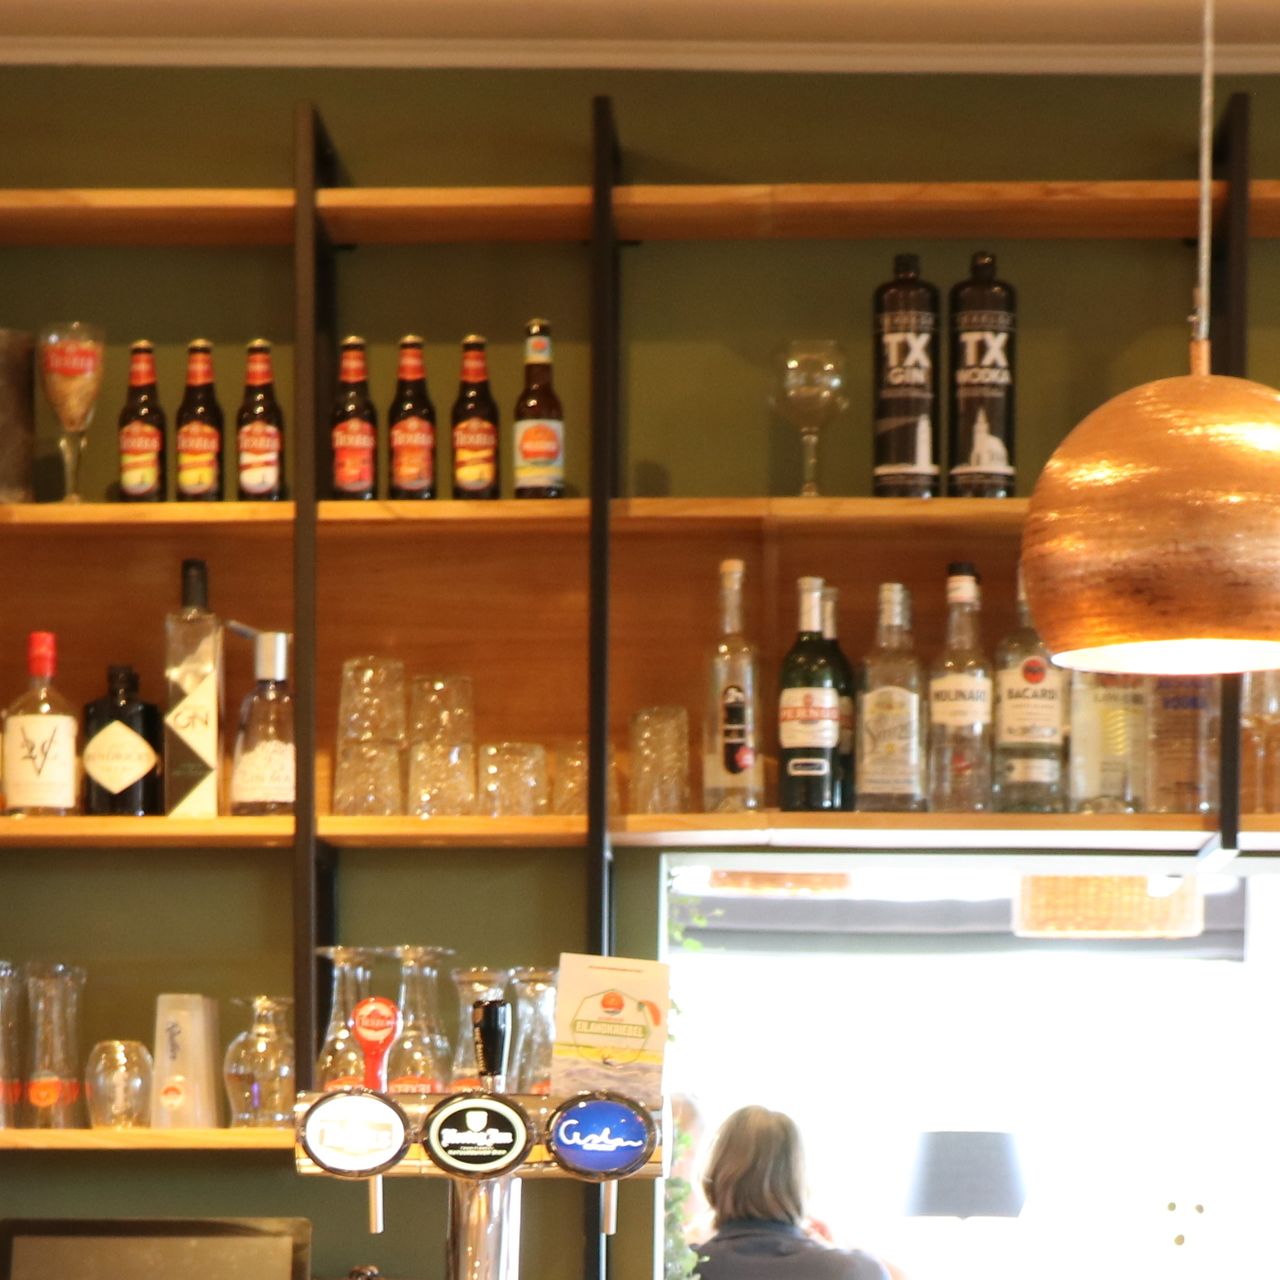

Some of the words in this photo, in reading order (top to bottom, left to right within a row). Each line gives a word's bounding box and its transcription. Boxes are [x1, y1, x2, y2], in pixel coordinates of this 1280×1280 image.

[882, 332, 931, 368] TX
[959, 332, 1008, 368] TX
[888, 367, 926, 384] GIN
[955, 368, 1012, 384] VODKA
